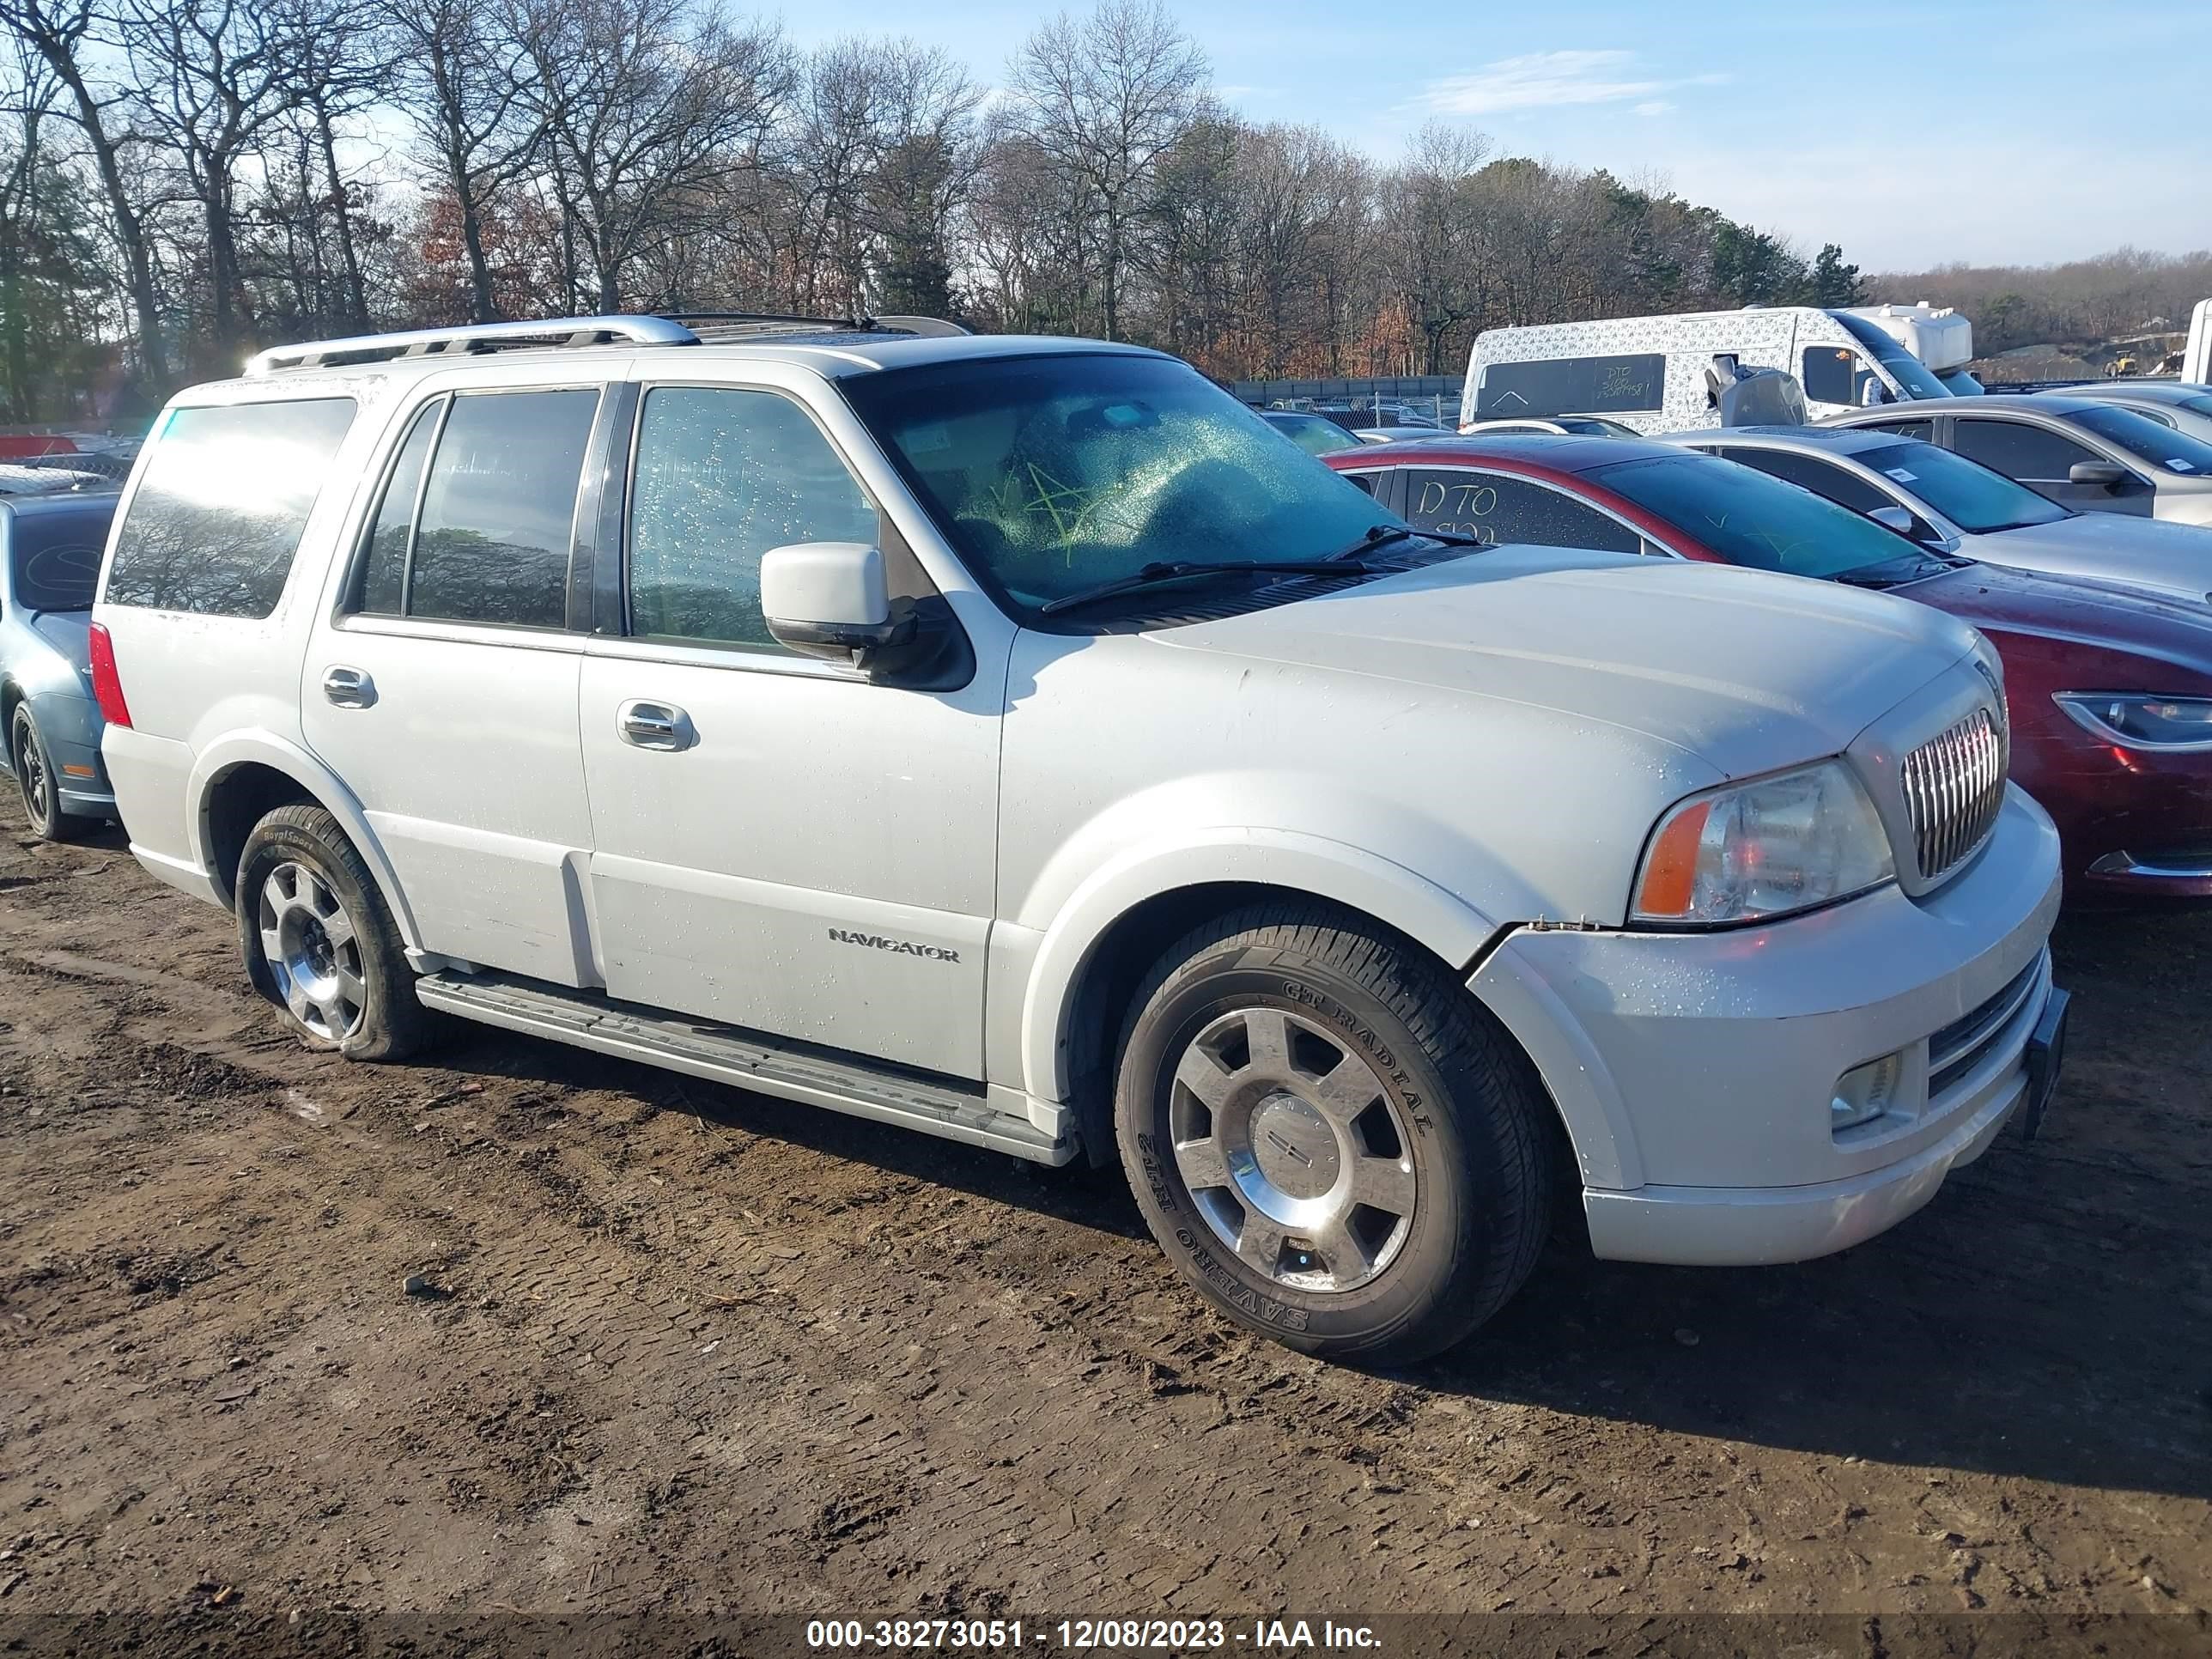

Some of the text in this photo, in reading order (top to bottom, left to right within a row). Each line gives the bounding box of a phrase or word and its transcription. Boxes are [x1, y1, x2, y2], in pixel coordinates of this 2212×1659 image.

[1419, 482, 1497, 515] DTO
[264, 830, 313, 851] RoyalSport
[828, 927, 962, 964] NAVIGATOR
[1282, 981, 1325, 1009] GT
[1332, 1004, 1432, 1138] RADIAL
[1138, 1133, 1177, 1213] HT2
[1176, 1228, 1310, 1331] SAVERO
